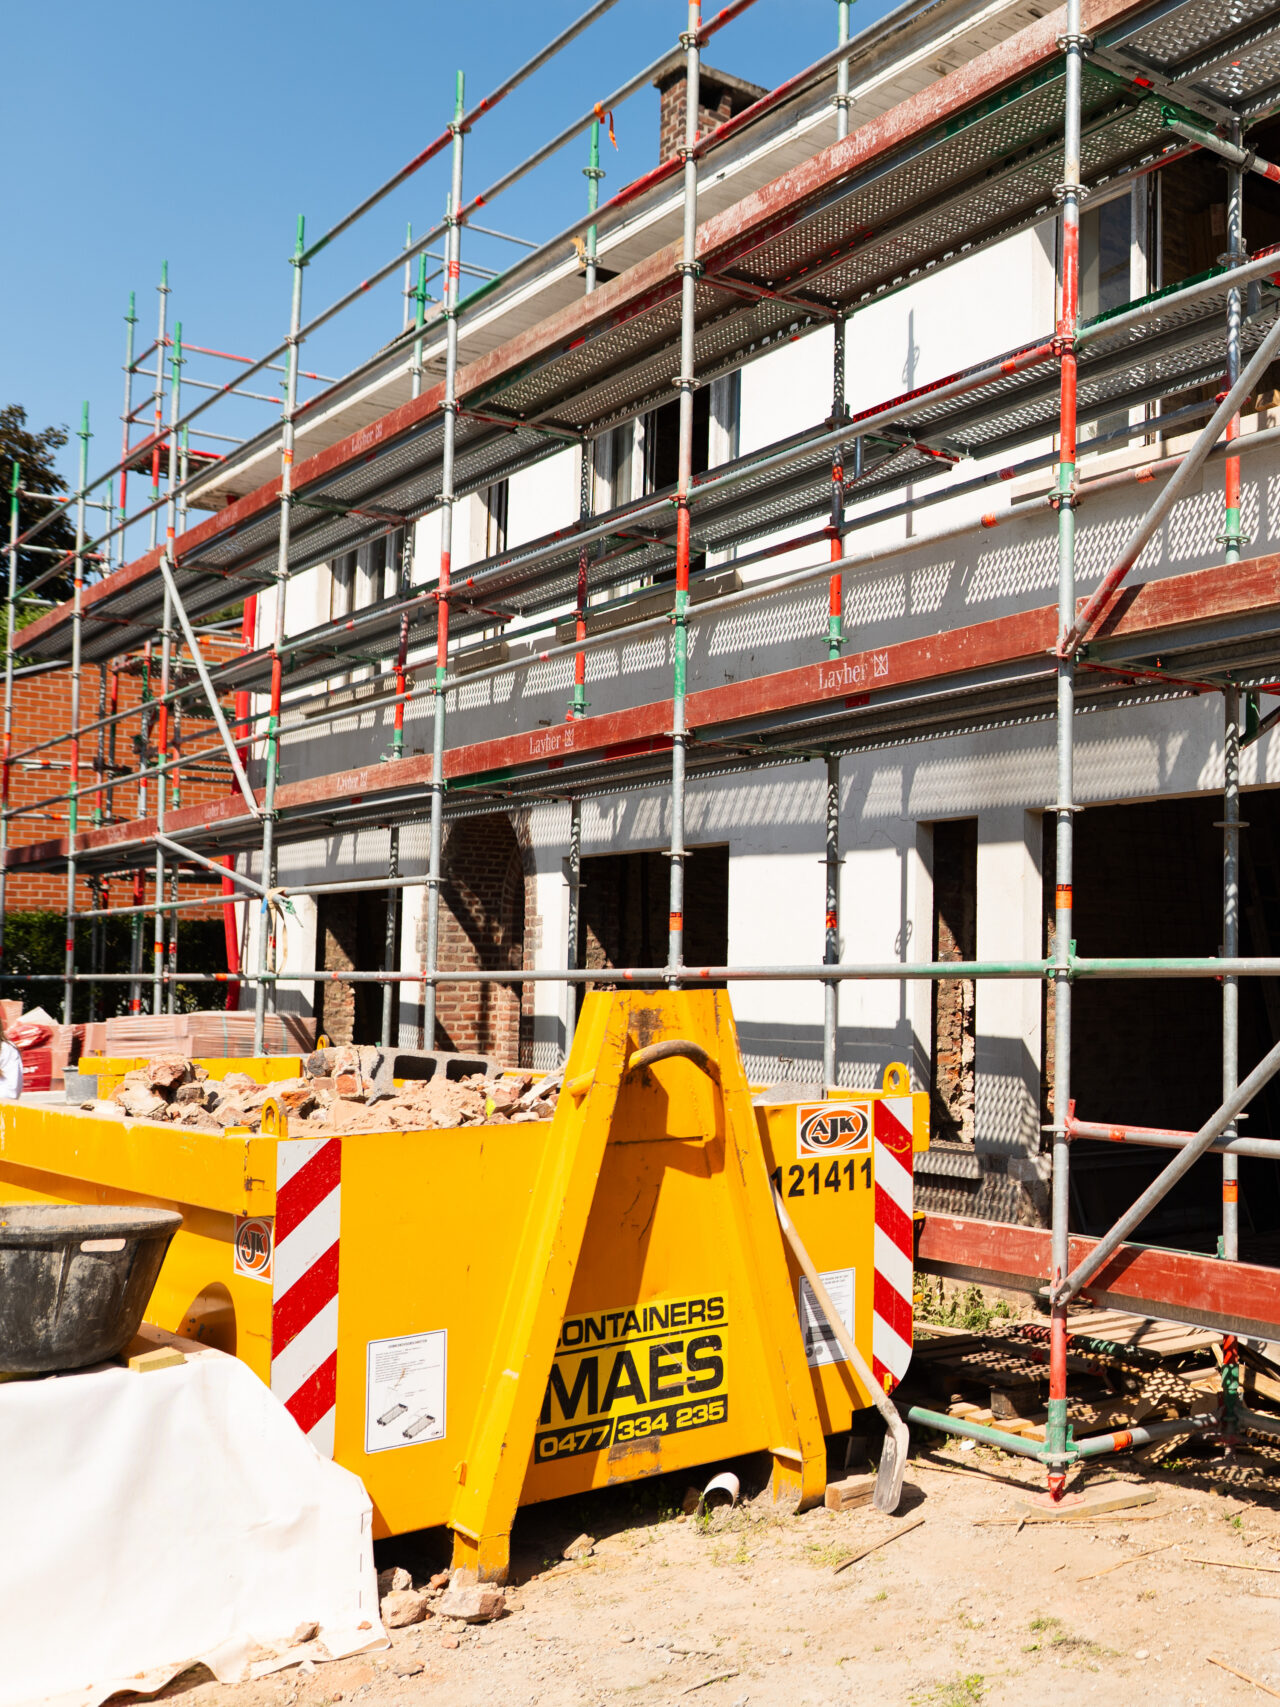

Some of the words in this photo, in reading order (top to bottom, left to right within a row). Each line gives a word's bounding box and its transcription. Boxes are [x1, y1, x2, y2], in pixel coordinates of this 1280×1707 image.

[818, 663, 868, 691] Layher
[529, 733, 561, 755] Layher
[810, 1115, 857, 1145] AJK
[771, 1157, 872, 1198] 121411
[241, 1230, 265, 1264] AJK
[555, 1296, 725, 1349] ONTAINERS
[540, 1335, 724, 1426] MAES
[676, 1400, 725, 1429] 235
